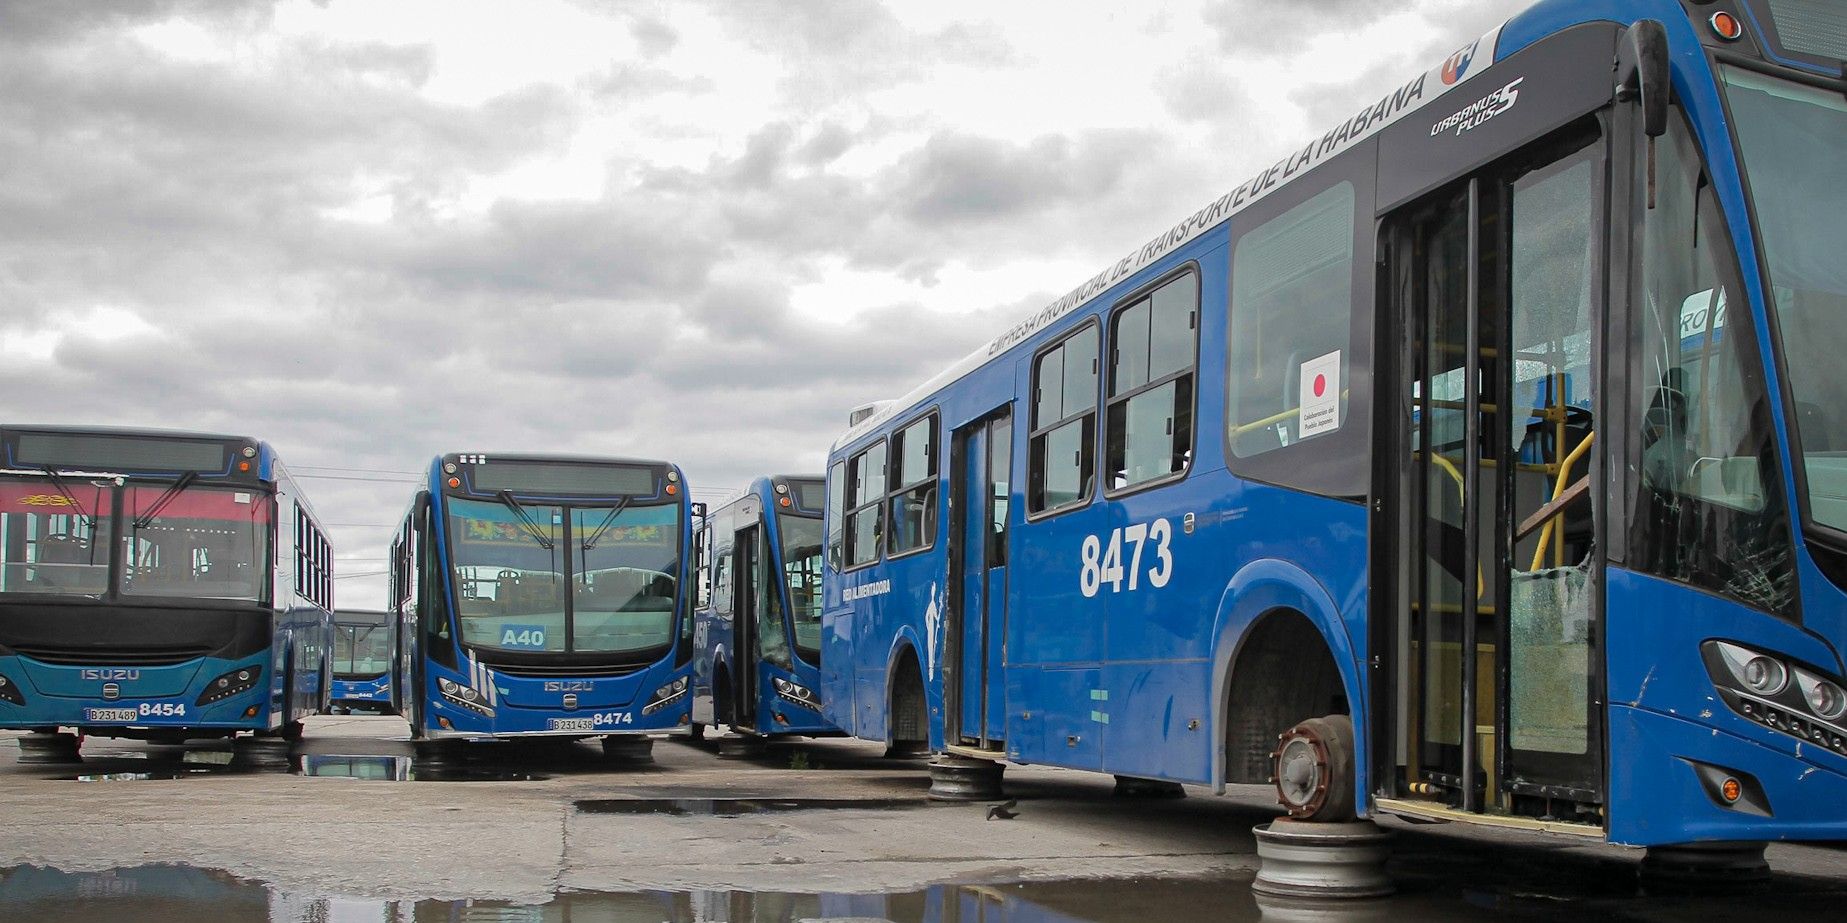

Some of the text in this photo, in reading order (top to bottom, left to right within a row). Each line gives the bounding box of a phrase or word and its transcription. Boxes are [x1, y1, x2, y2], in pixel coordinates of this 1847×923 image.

[988, 71, 1428, 355] EMPRESA PROVINCIAL DE TRANSPORTE DE LA HABANA
[1080, 518, 1173, 597] 8473
[852, 579, 891, 600] ALIMENTADORA
[501, 629, 544, 646] A40
[81, 669, 140, 680] ISUZU
[544, 681, 594, 692] ISUZU
[139, 703, 186, 716] 8454
[593, 712, 633, 725] 8474
